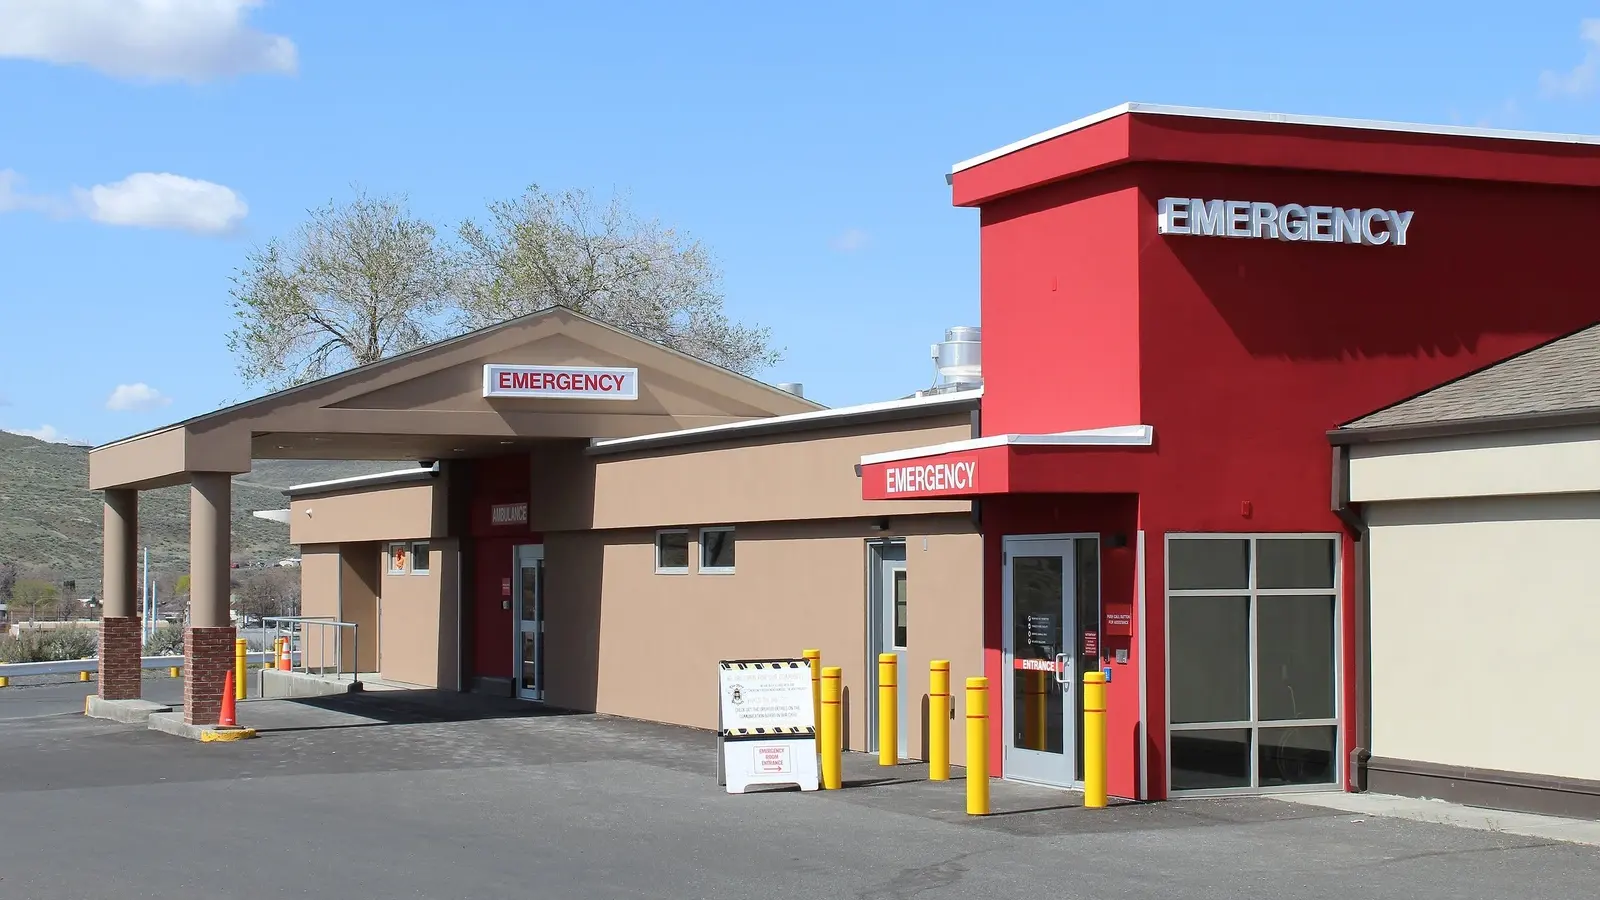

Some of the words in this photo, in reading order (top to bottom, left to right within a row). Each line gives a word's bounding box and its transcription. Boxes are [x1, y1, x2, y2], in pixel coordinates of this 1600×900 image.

[1157, 197, 1415, 246] EMERGENCY
[499, 371, 625, 391] EMERGENCY
[886, 462, 976, 493] EMERGENCY
[492, 505, 527, 522] AMBULANCE
[1022, 660, 1055, 672] ENTRANCE
